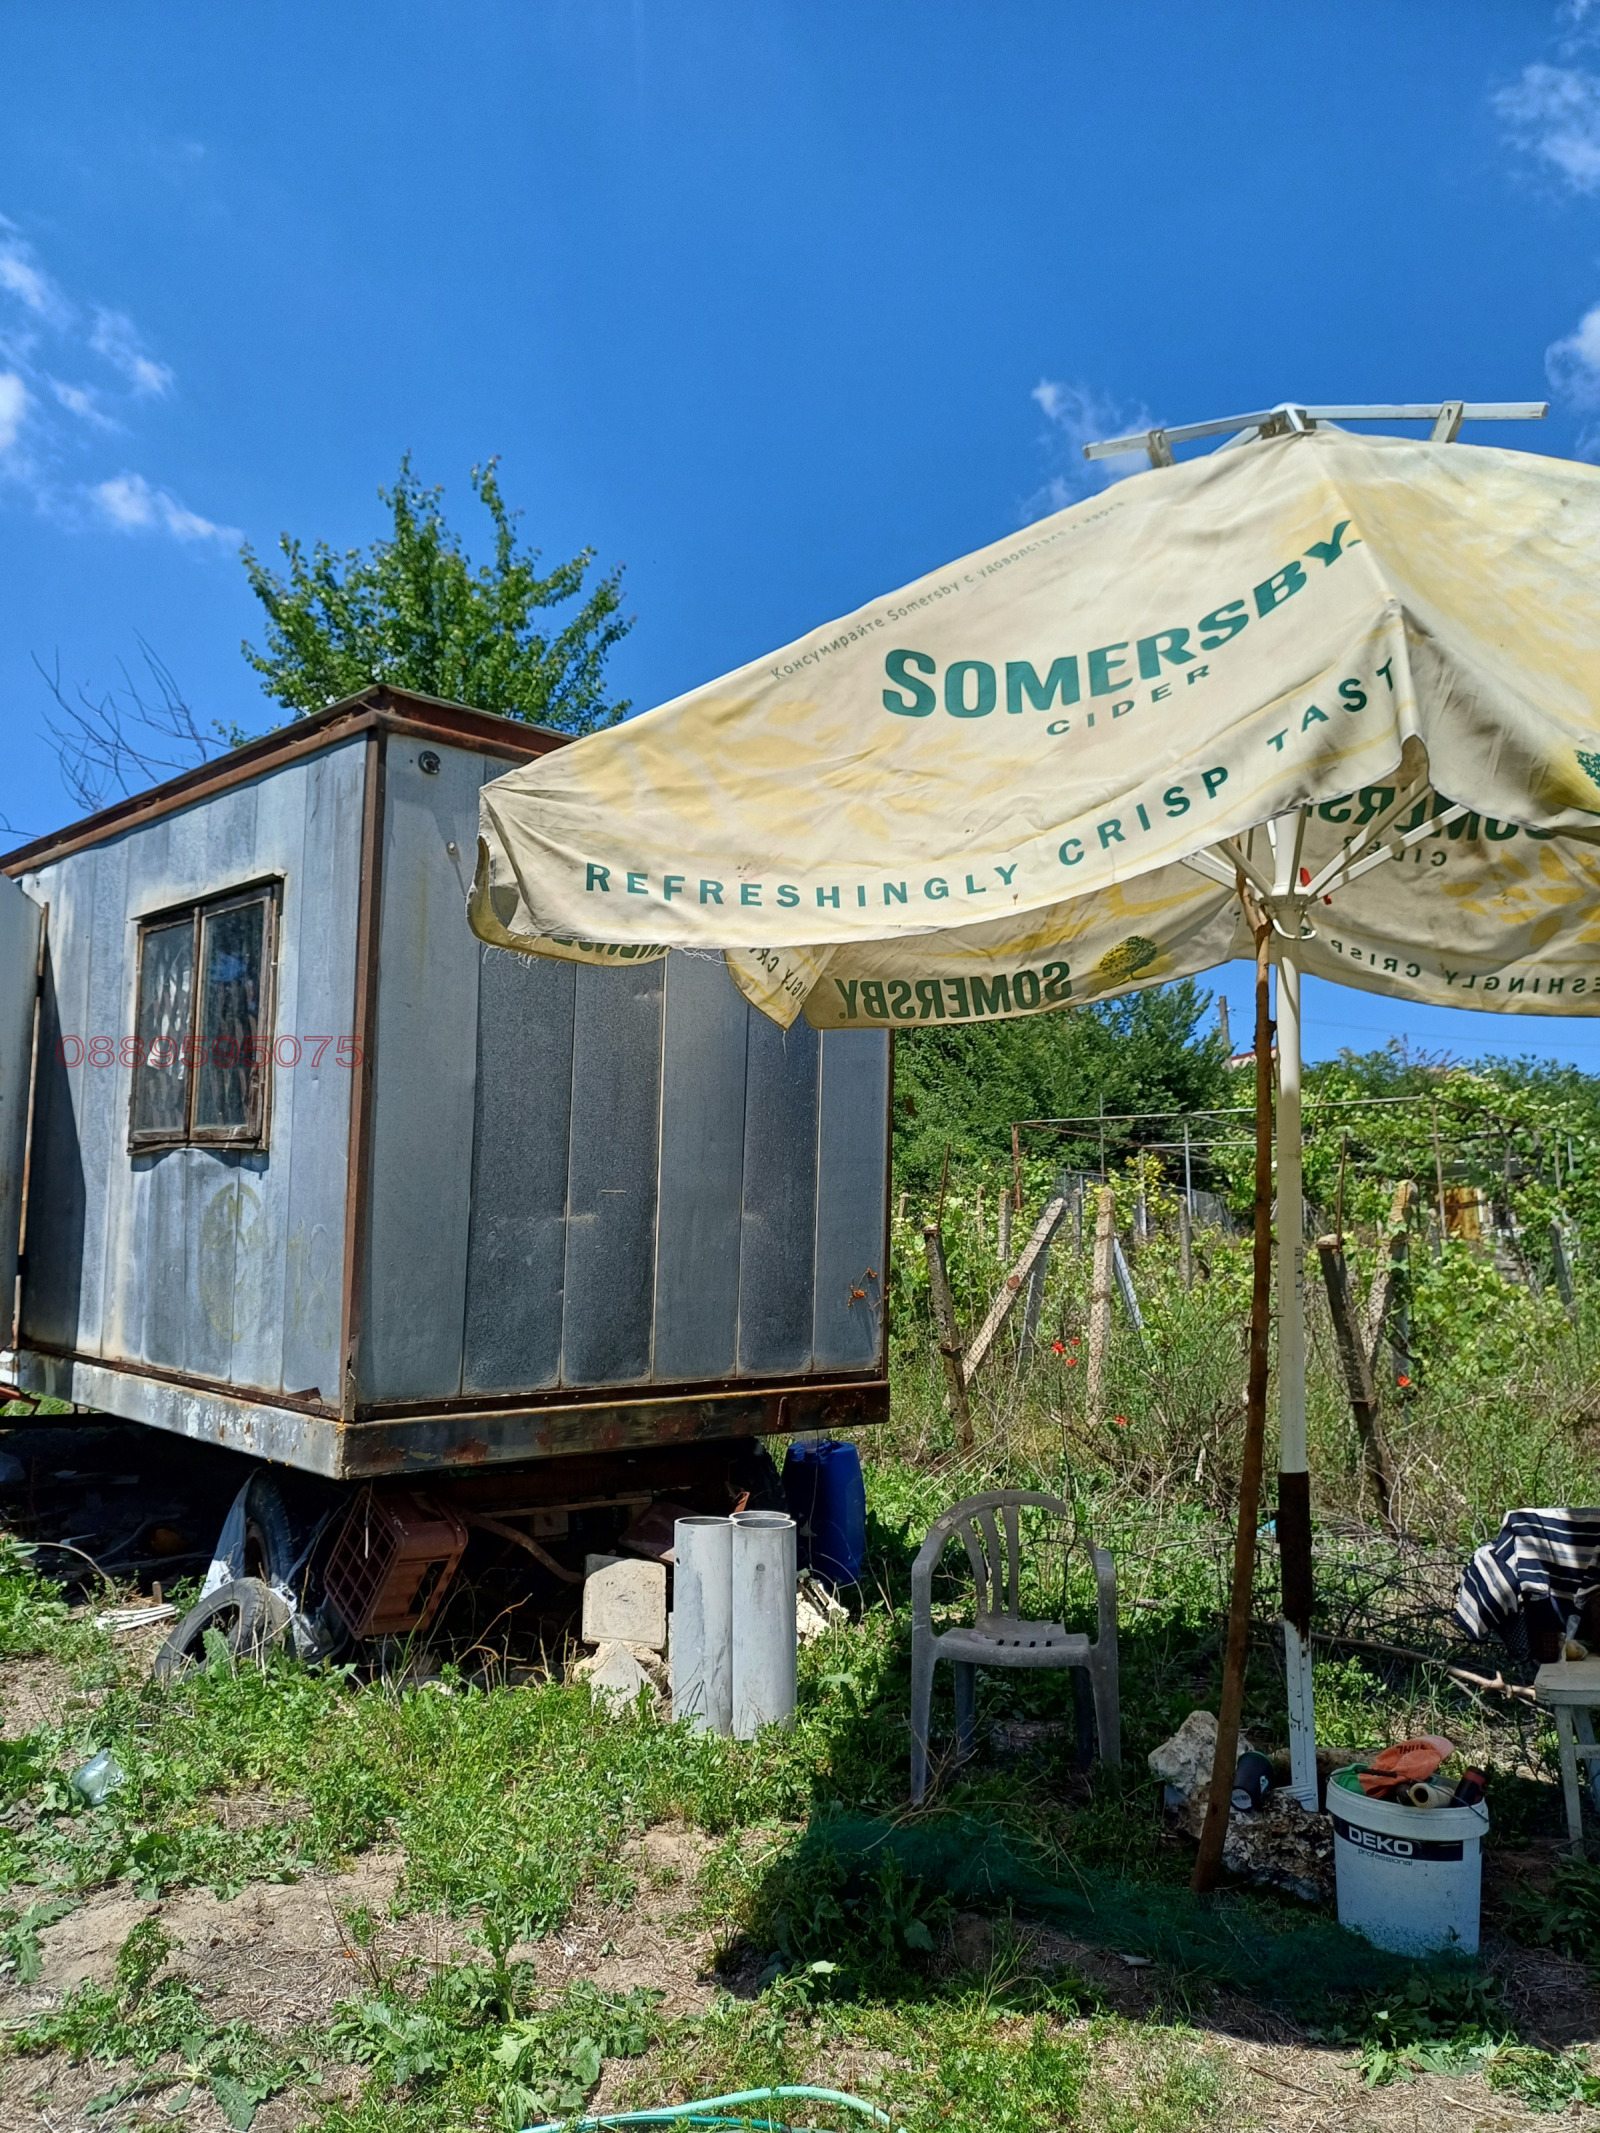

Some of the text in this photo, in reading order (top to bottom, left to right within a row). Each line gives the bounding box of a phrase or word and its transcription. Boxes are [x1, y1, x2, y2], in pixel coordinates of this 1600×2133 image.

[770, 617, 885, 681] Консумирайте
[887, 579, 960, 622] Somersby
[1046, 665, 1210, 736] CIDER
[586, 863, 1019, 909] REFRESHINGLY
[1058, 766, 1229, 866] CRISP
[1348, 1825, 1414, 1856] DEKO
[1358, 1848, 1413, 1867] professional
